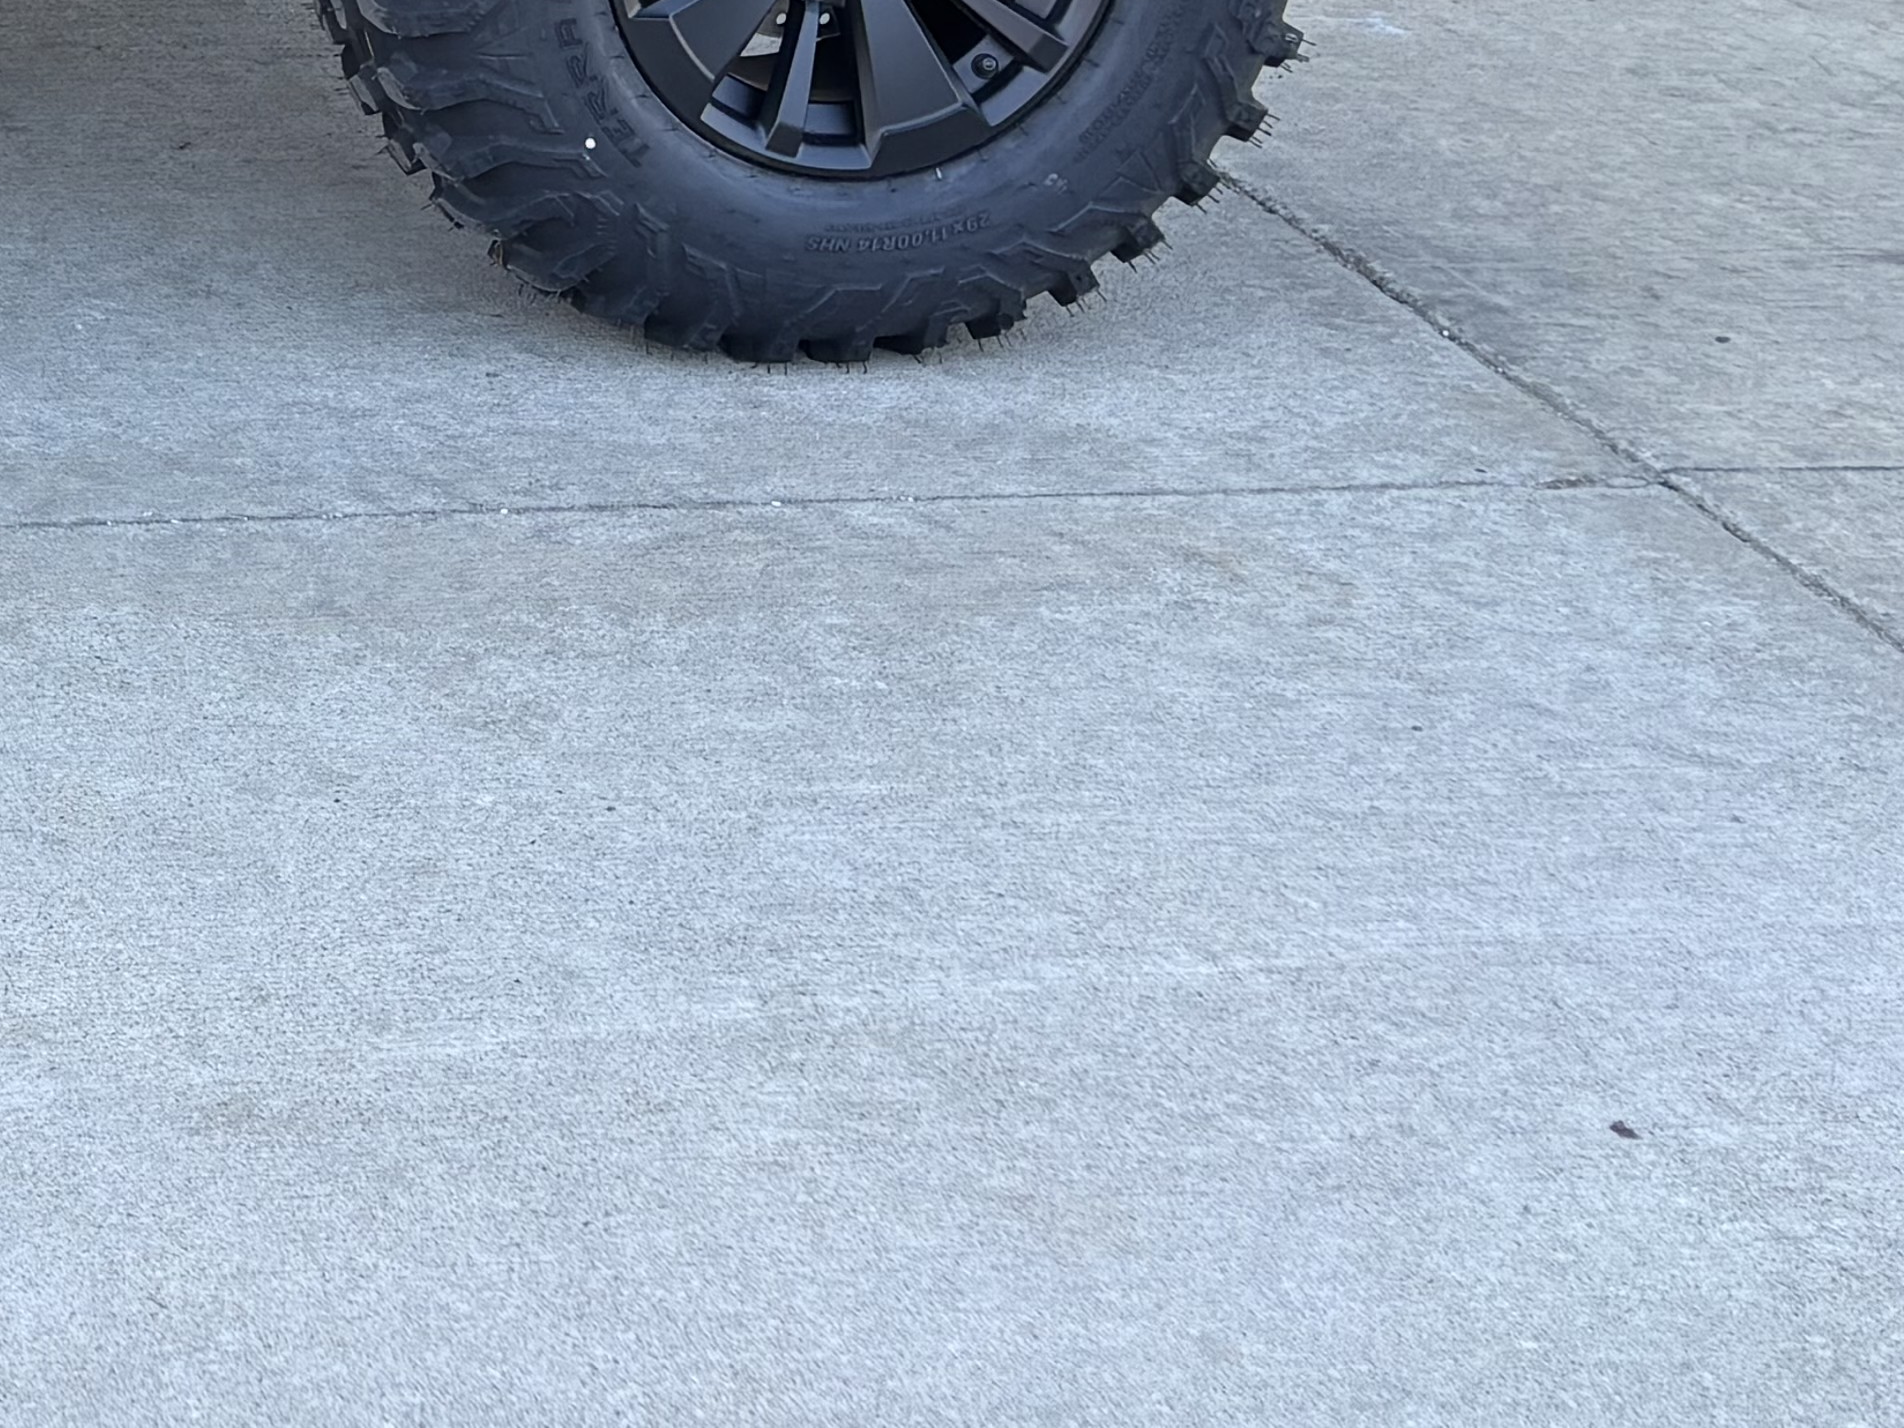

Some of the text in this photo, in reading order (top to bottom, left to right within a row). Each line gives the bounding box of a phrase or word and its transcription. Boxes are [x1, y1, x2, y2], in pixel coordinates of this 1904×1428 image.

[552, 17, 650, 169] TERRA
[806, 235, 851, 253] NHS
[857, 209, 992, 252] 29x11.00R14
